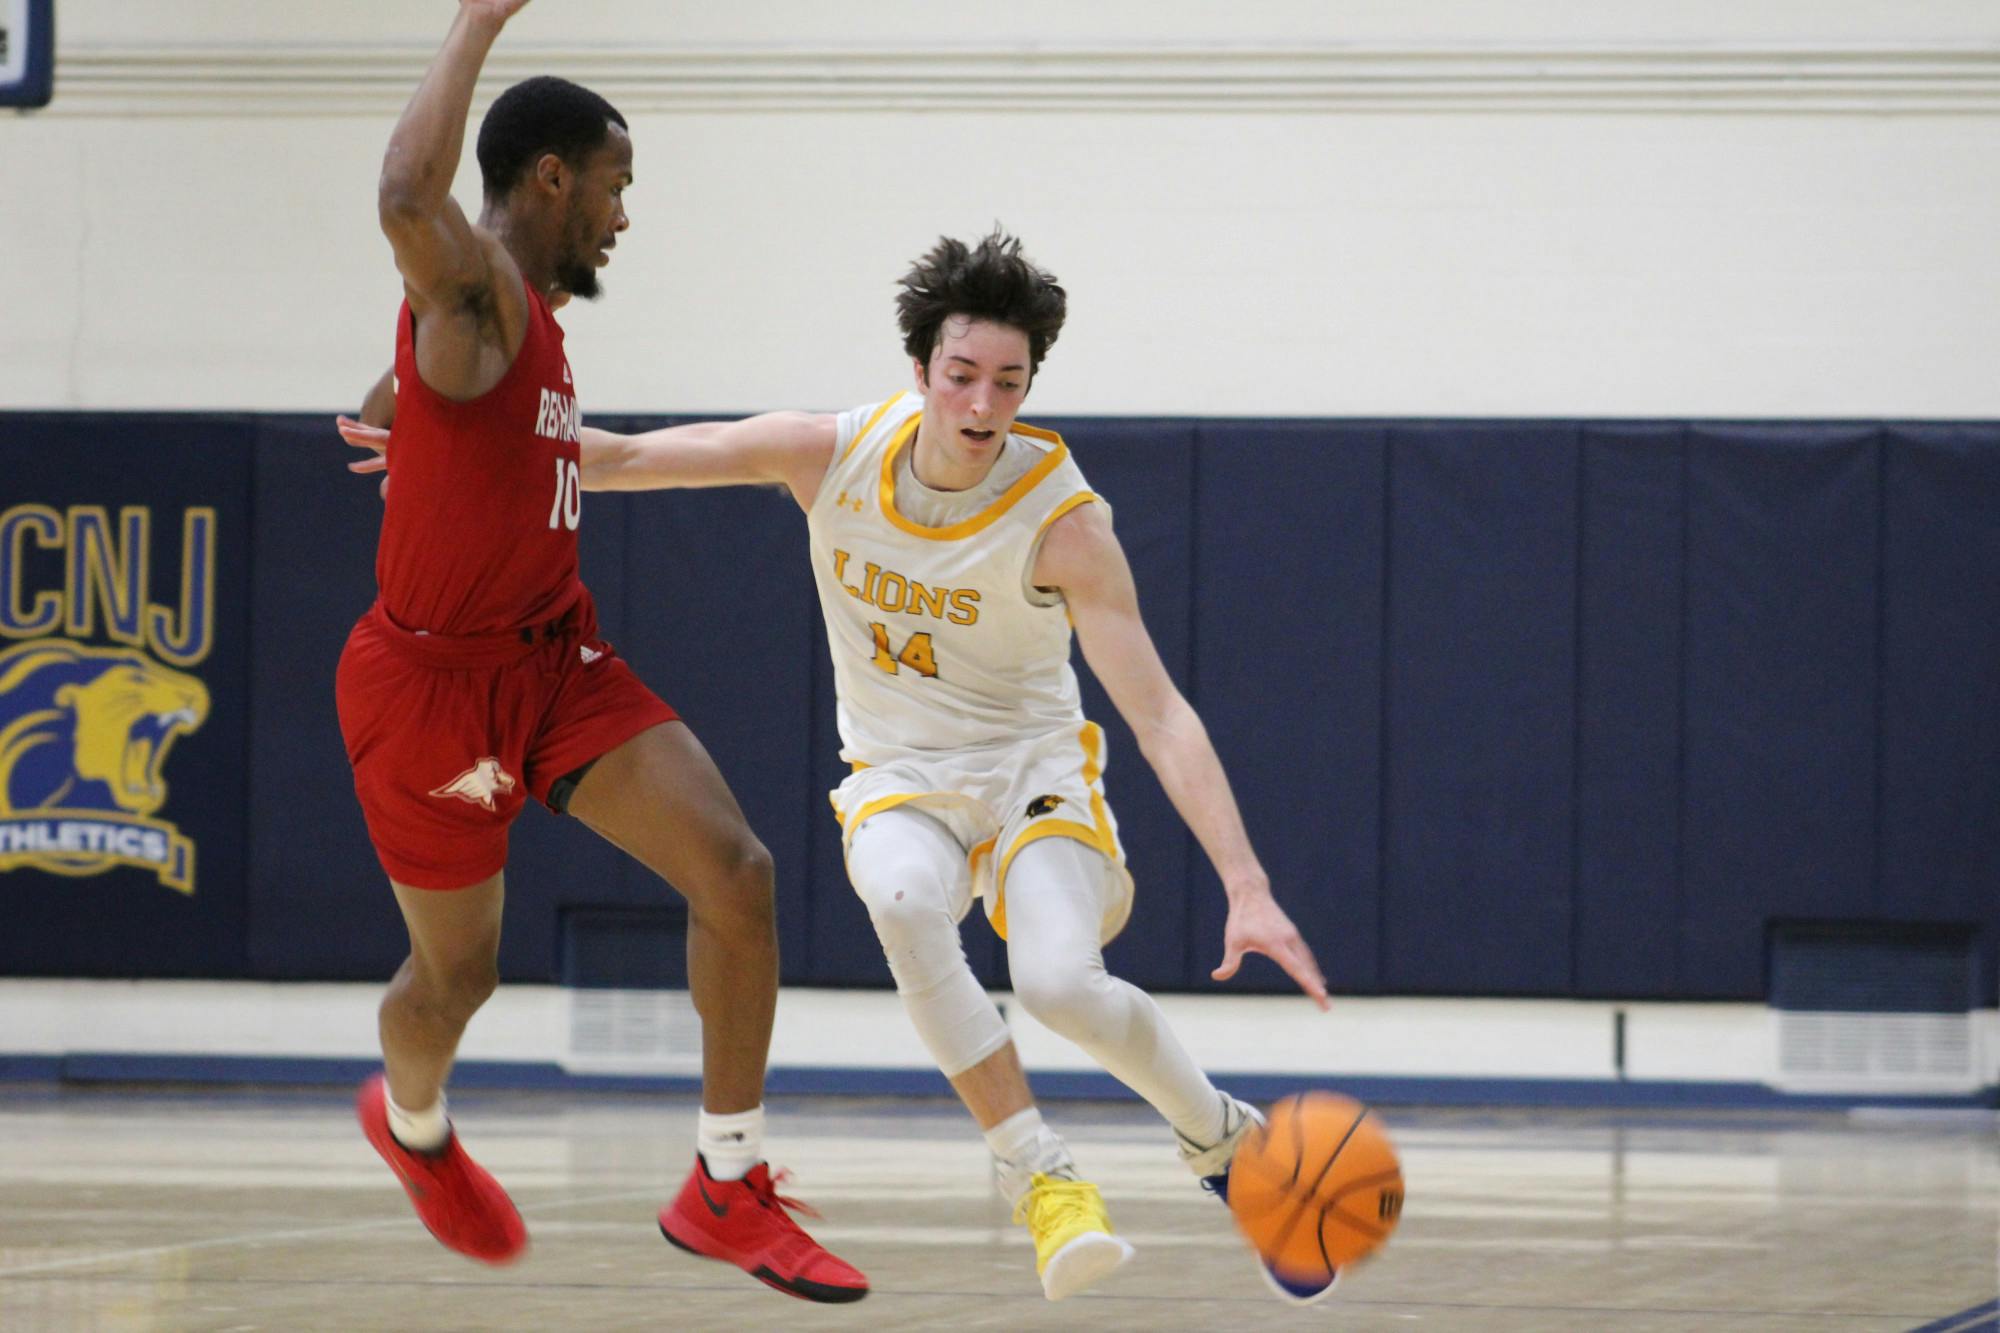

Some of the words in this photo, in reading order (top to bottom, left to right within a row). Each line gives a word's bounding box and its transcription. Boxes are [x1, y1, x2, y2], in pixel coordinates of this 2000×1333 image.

[549, 458, 581, 531] 10
[0, 504, 216, 667] CNJ
[834, 548, 981, 625] LIONS
[869, 621, 938, 678] 14
